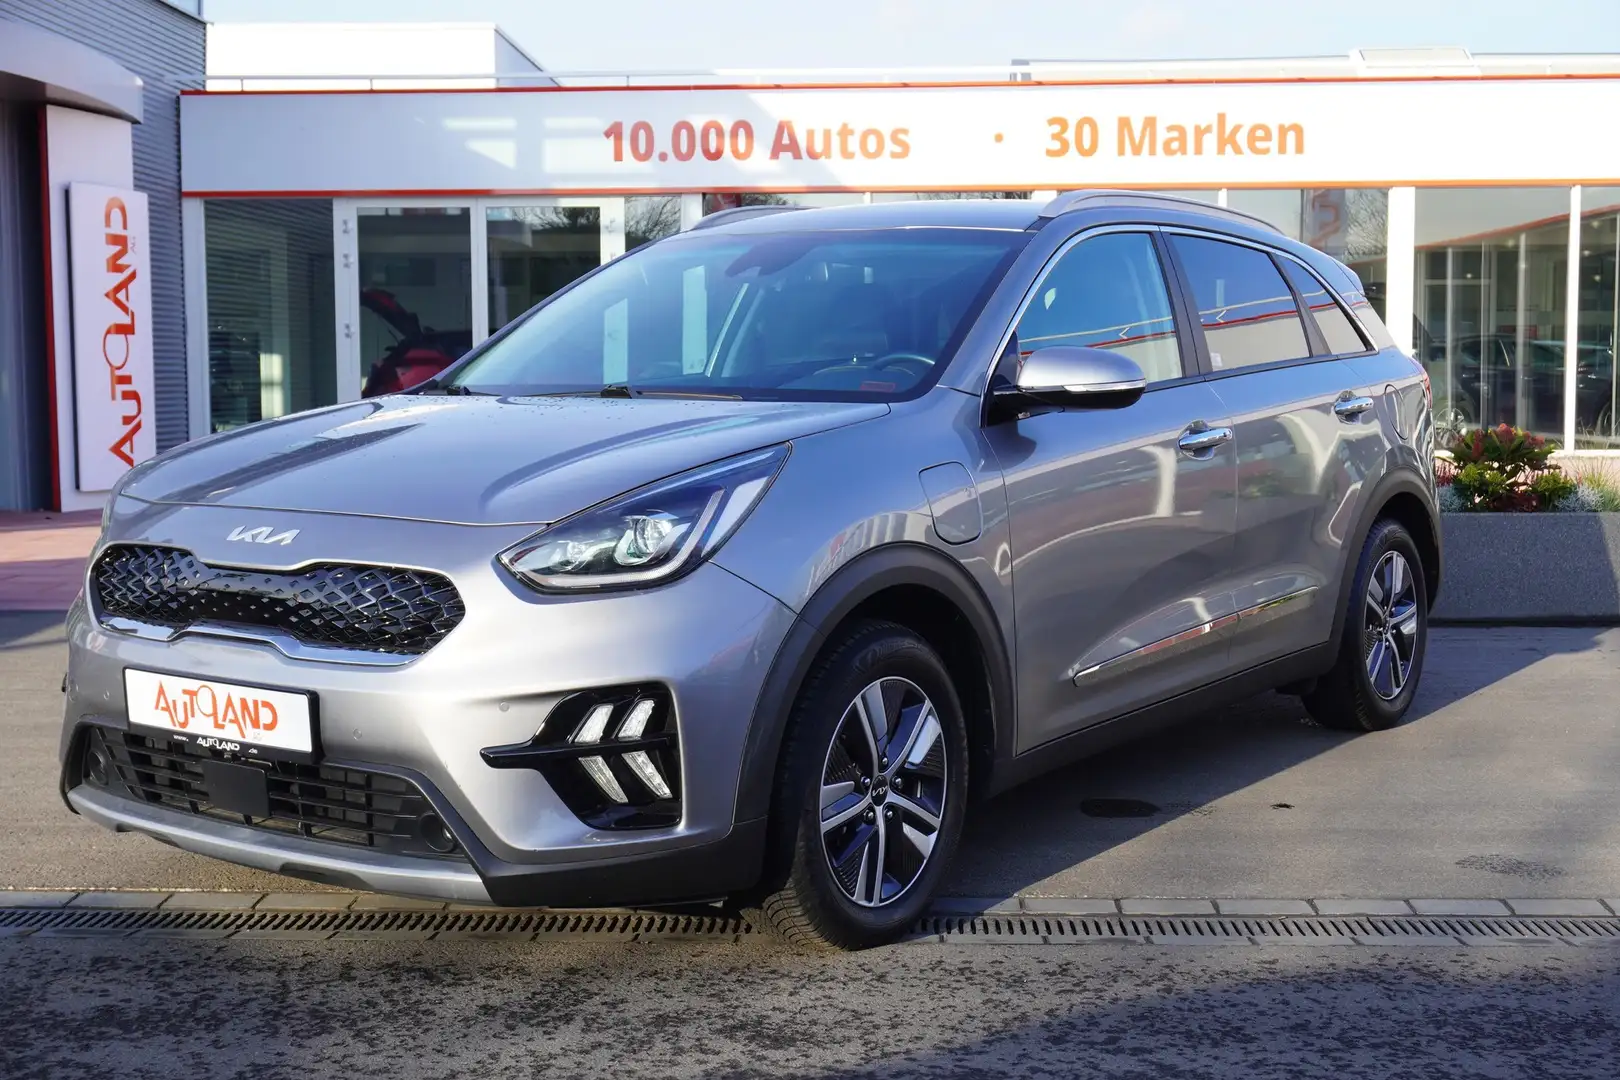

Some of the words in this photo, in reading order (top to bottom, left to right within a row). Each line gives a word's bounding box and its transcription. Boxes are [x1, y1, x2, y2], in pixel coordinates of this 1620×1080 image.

[603, 119, 754, 162] 10.000
[769, 119, 911, 160] Autos
[1045, 116, 1098, 157] 30
[1116, 112, 1304, 156] Marken
[103, 196, 142, 467] AUTOLAND
[154, 681, 278, 739] AUTOLAND
[196, 736, 240, 751] AUTOLAND
